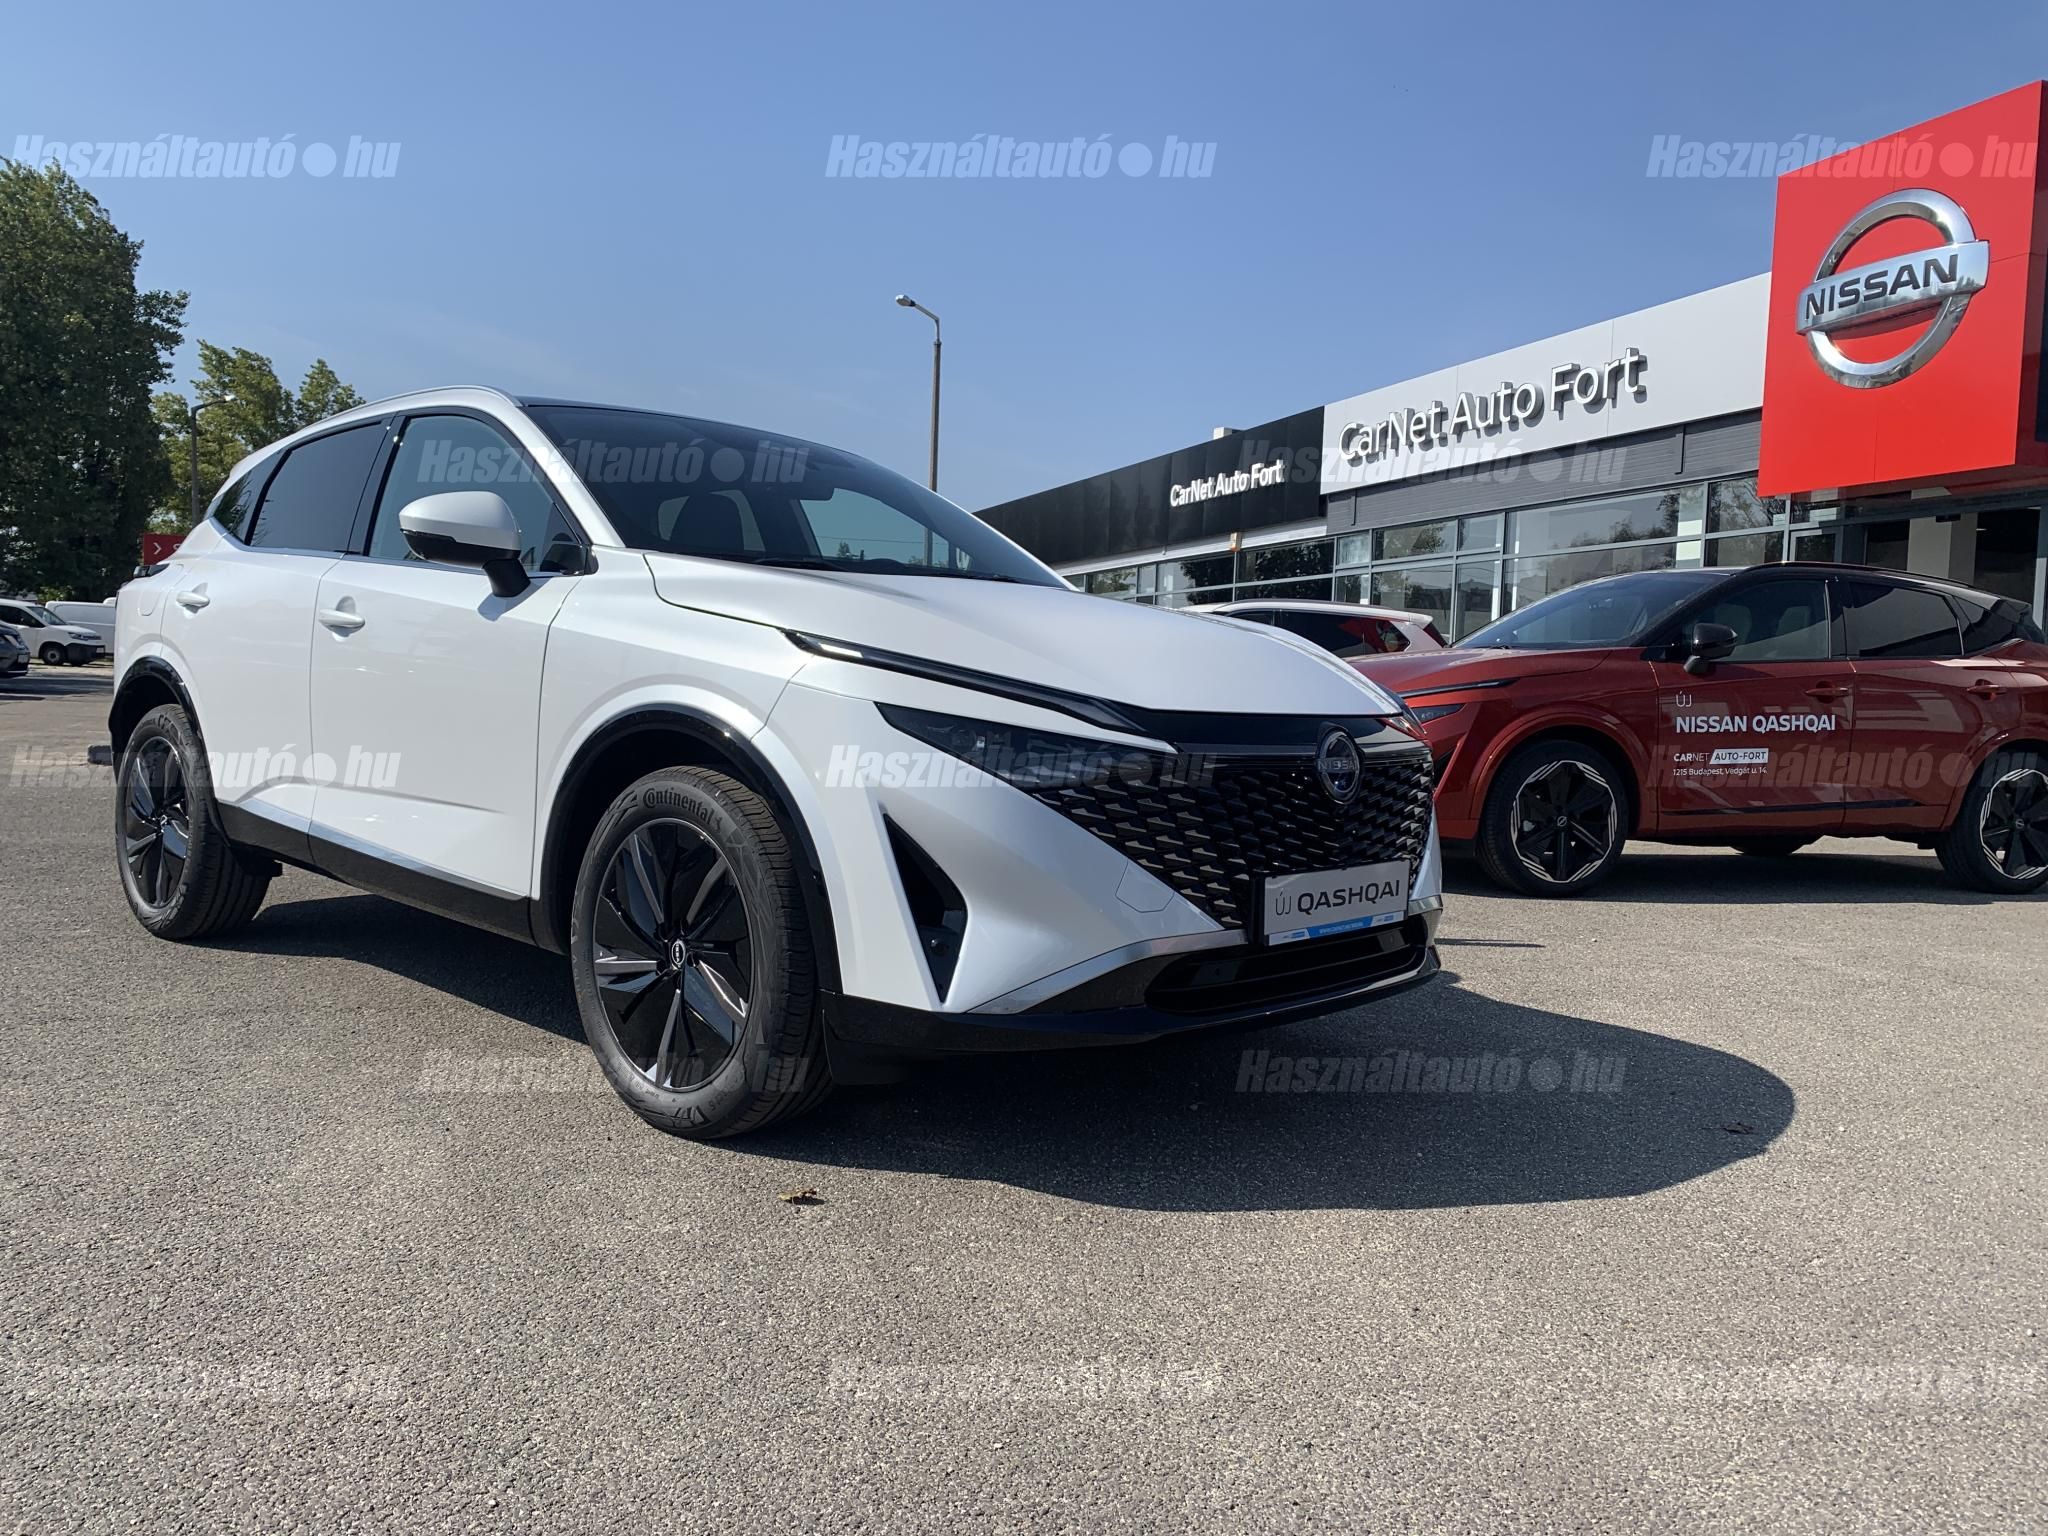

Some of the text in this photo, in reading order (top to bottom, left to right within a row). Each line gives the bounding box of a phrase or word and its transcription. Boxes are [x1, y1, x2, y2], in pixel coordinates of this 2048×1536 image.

[1805, 254, 1958, 319] NISSAN
[1339, 348, 1645, 461] CarNet Auto Fort
[1169, 459, 1285, 507] CarNet Auto Fort
[1676, 714, 1836, 734] NISSAN QASHQAI
[1672, 768, 1687, 776] 1215
[1673, 751, 1767, 762] CARNET AUTO-FORT
[643, 787, 714, 825] Continental
[1275, 880, 1400, 916] ÚJ QASHQAI
